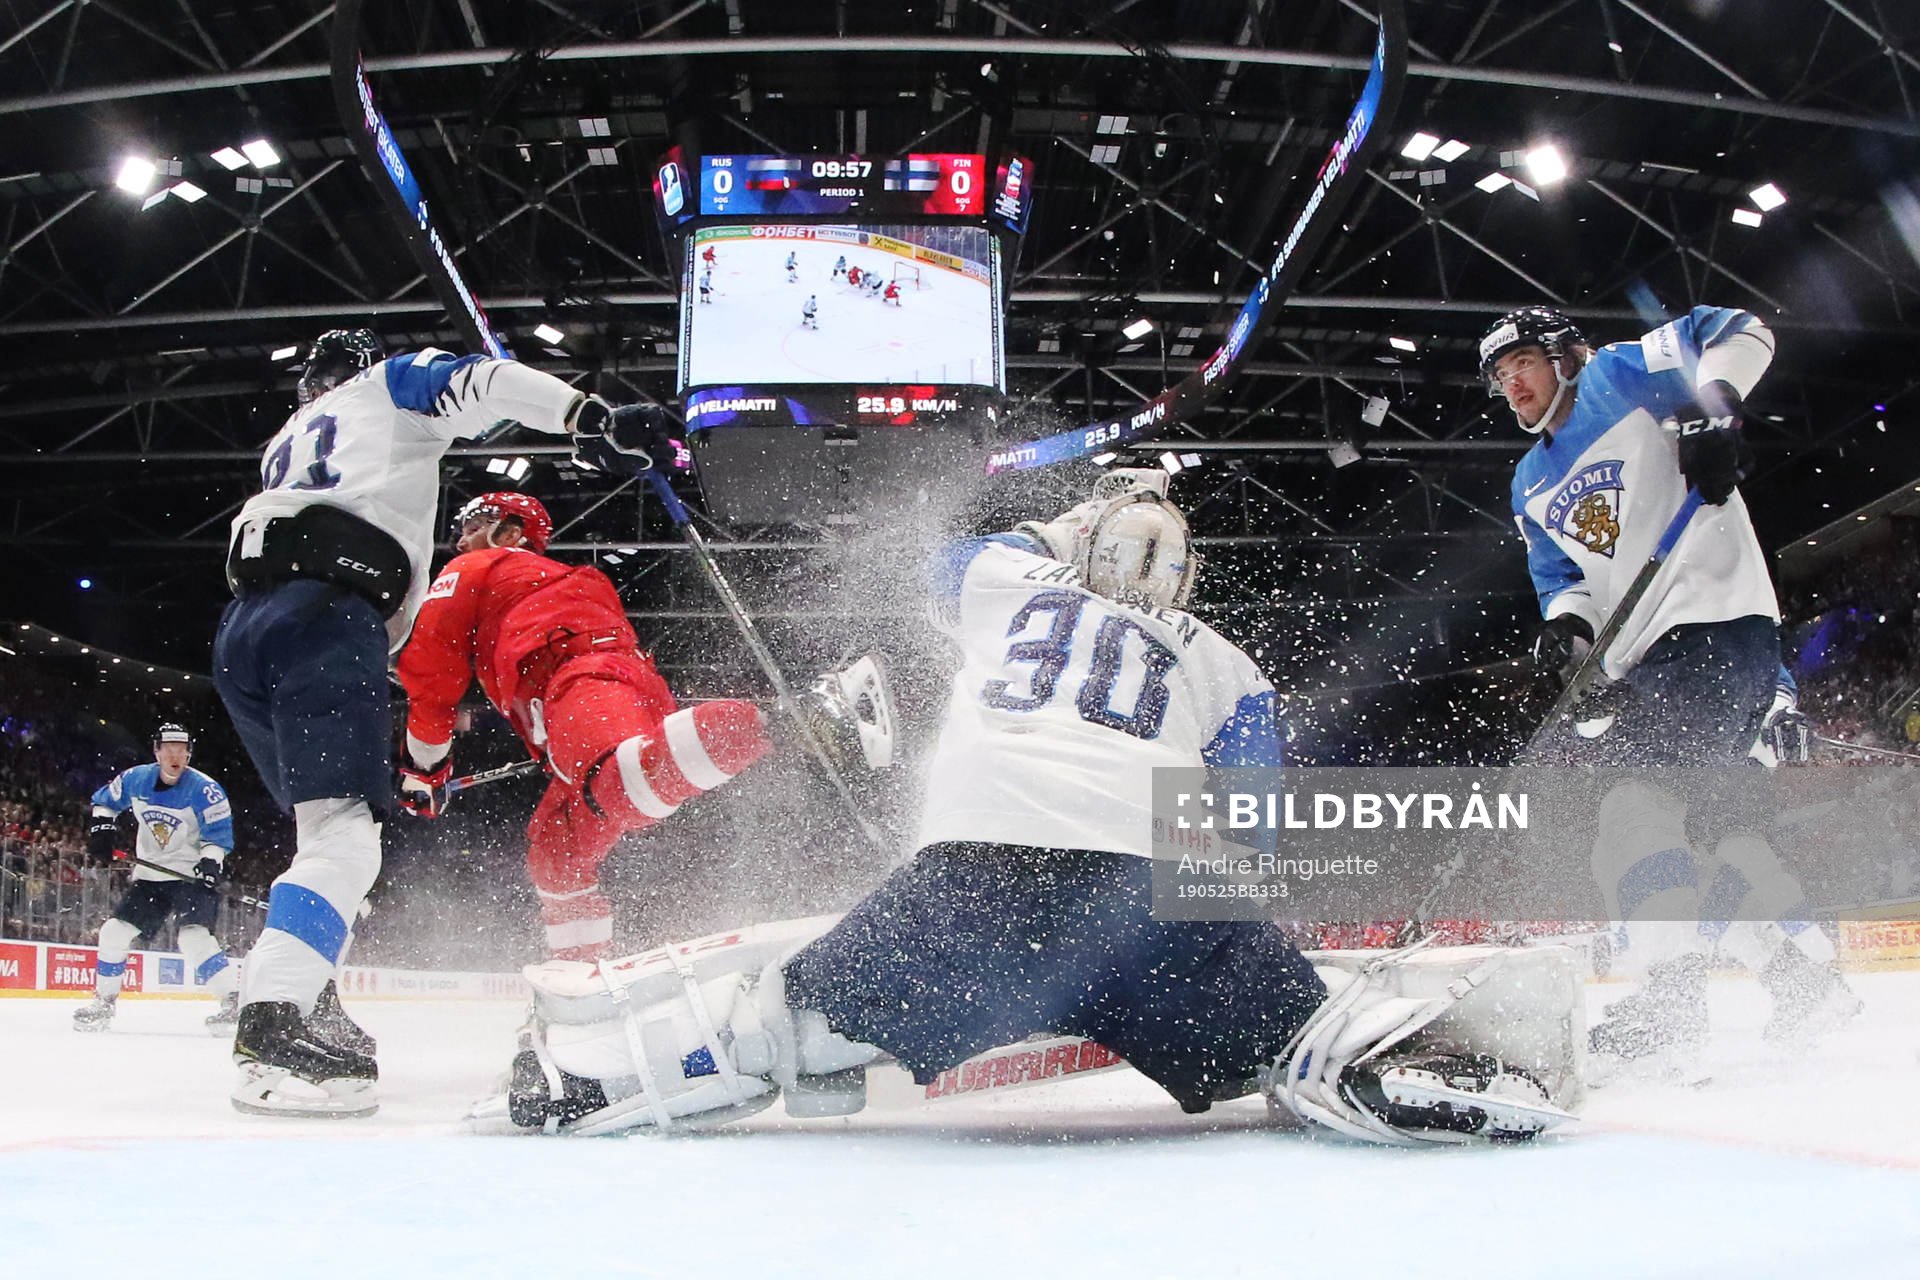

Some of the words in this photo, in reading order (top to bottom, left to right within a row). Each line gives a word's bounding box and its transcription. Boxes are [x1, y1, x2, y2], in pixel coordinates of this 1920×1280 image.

[711, 158, 733, 167] RUS
[812, 161, 872, 178] 09:57
[953, 159, 972, 167] FIN
[713, 170, 733, 194] 0
[951, 171, 970, 195] 0
[820, 188, 856, 197] PERIOD
[858, 188, 864, 197] 1
[752, 226, 816, 238] ФОНБЕТ
[699, 397, 776, 413] VELI-MATTI
[857, 397, 906, 413] 25.9
[912, 398, 957, 412] KM/H
[1084, 422, 1121, 448] 25.9
[1131, 402, 1166, 431] KM/H
[1549, 466, 1613, 523] SUOMI
[336, 556, 381, 577] CCM
[980, 588, 1179, 740] 30
[202, 783, 224, 804] 25
[143, 810, 178, 826] SUOMI
